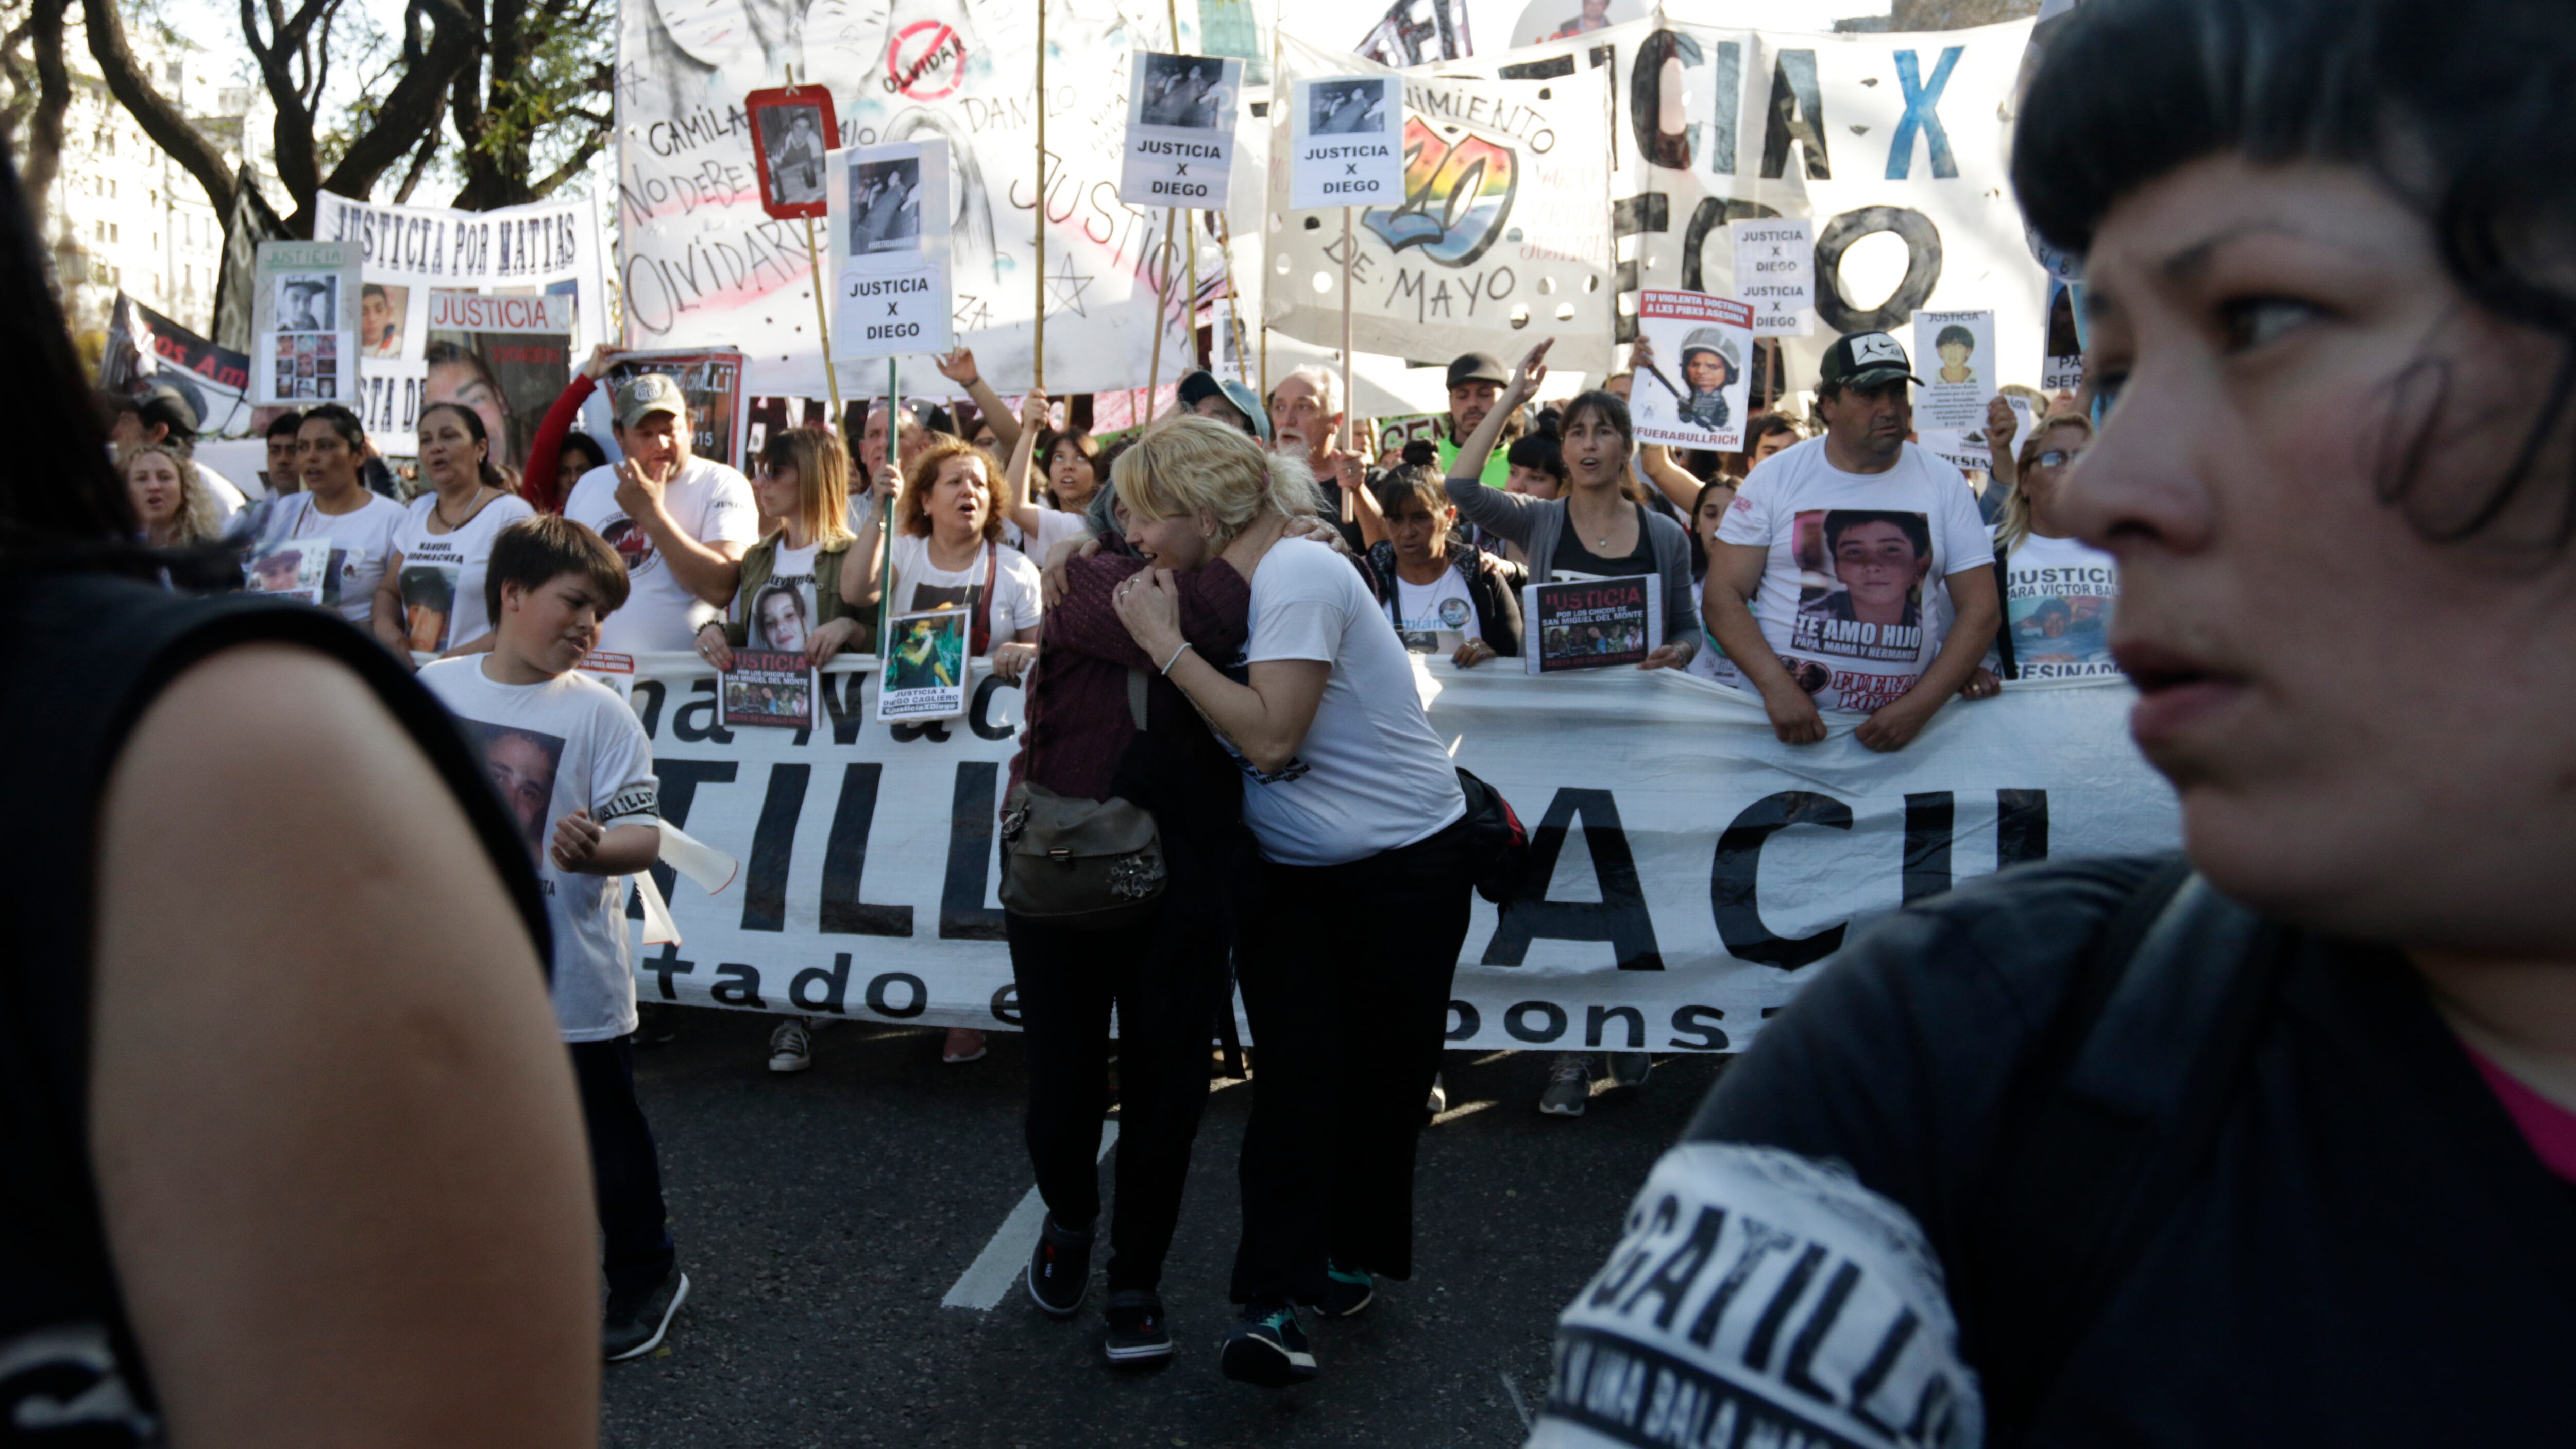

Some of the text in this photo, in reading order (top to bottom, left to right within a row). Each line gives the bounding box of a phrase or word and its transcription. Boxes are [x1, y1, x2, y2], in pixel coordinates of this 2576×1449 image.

[1885, 45, 1965, 180] X
[1137, 140, 1222, 159] JUSTICIA
[1304, 145, 1389, 160] JUSTICIA
[1176, 162, 1188, 176] X
[1346, 163, 1357, 175] X
[1151, 181, 1208, 197] DIEGO
[1323, 180, 1379, 194] DIEGO
[619, 164, 667, 226] NO
[1742, 231, 1803, 241] JUSTICIA
[452, 223, 488, 275] POR
[498, 212, 575, 276] MATIAS
[1772, 246, 1780, 256] X
[1756, 261, 1797, 272] DIEGO
[850, 278, 928, 297] JUSTICIA
[1744, 286, 1804, 296] JUSTICIA
[1385, 266, 1515, 324] MAYO
[887, 302, 899, 316] X
[1645, 293, 1749, 315] TU VIOLENTA DOCTRINA
[1773, 302, 1780, 311] X
[435, 298, 549, 329] JUSTICIA
[1646, 304, 1745, 323] A LXS PIBXS ASESINA
[1928, 312, 1979, 322] JUSTICIA
[1756, 317, 1797, 327] DIEGO
[867, 323, 920, 340] DIEGO
[2041, 584, 2090, 596] VICTOR
[1561, 616, 1594, 624] MIGUEL
[1614, 610, 1643, 619] MONTE
[1798, 614, 1922, 649] TE AMO HIJO
[1860, 646, 1867, 656] Y
[1868, 647, 1917, 660] HERMANOS
[1833, 671, 1917, 694] FUERZA
[895, 688, 936, 697] JUSTICIA
[883, 695, 958, 706] DIEGO CAGLIERO
